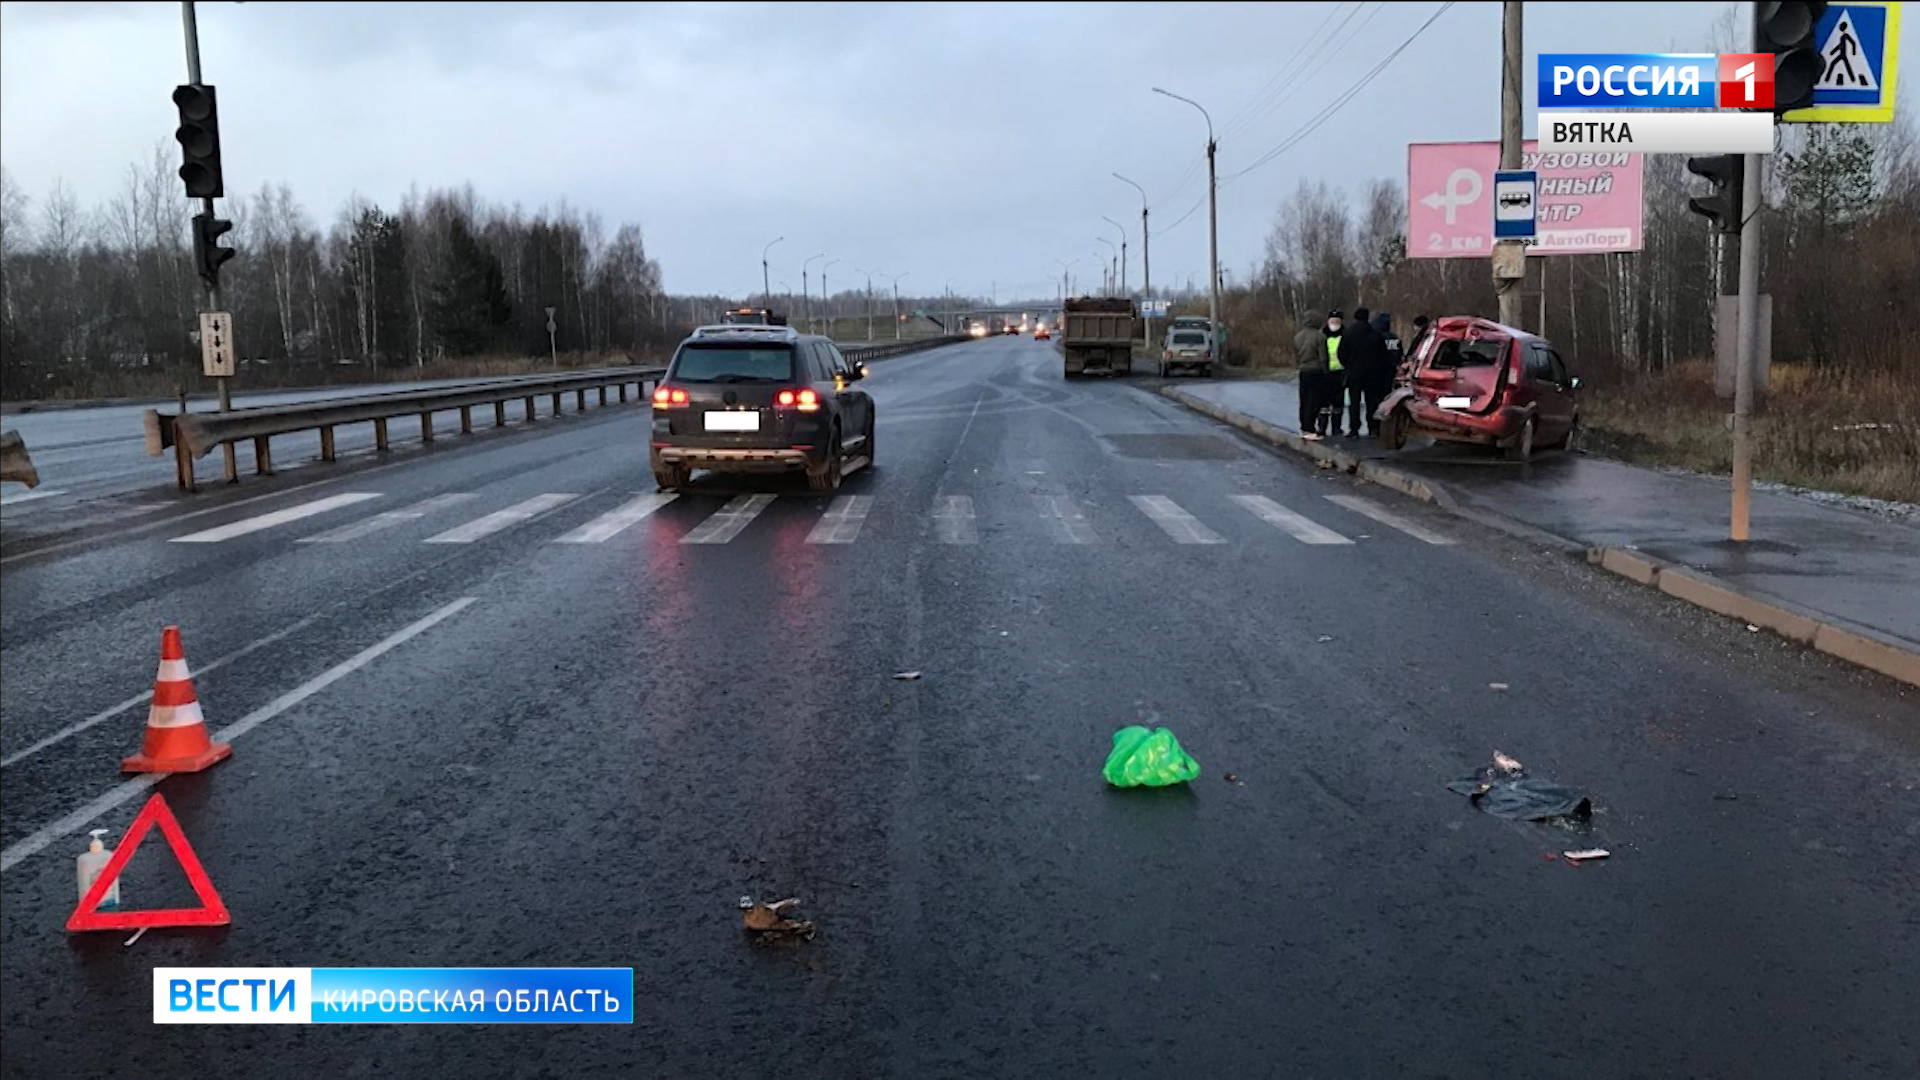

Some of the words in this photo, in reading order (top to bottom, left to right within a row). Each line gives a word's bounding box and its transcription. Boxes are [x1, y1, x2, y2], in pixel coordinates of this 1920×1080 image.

[1540, 173, 1613, 195] ННЫЙ
[1537, 204, 1583, 222] НТР
[1428, 232, 1443, 251] 2
[1544, 233, 1627, 248] АвтоПорт
